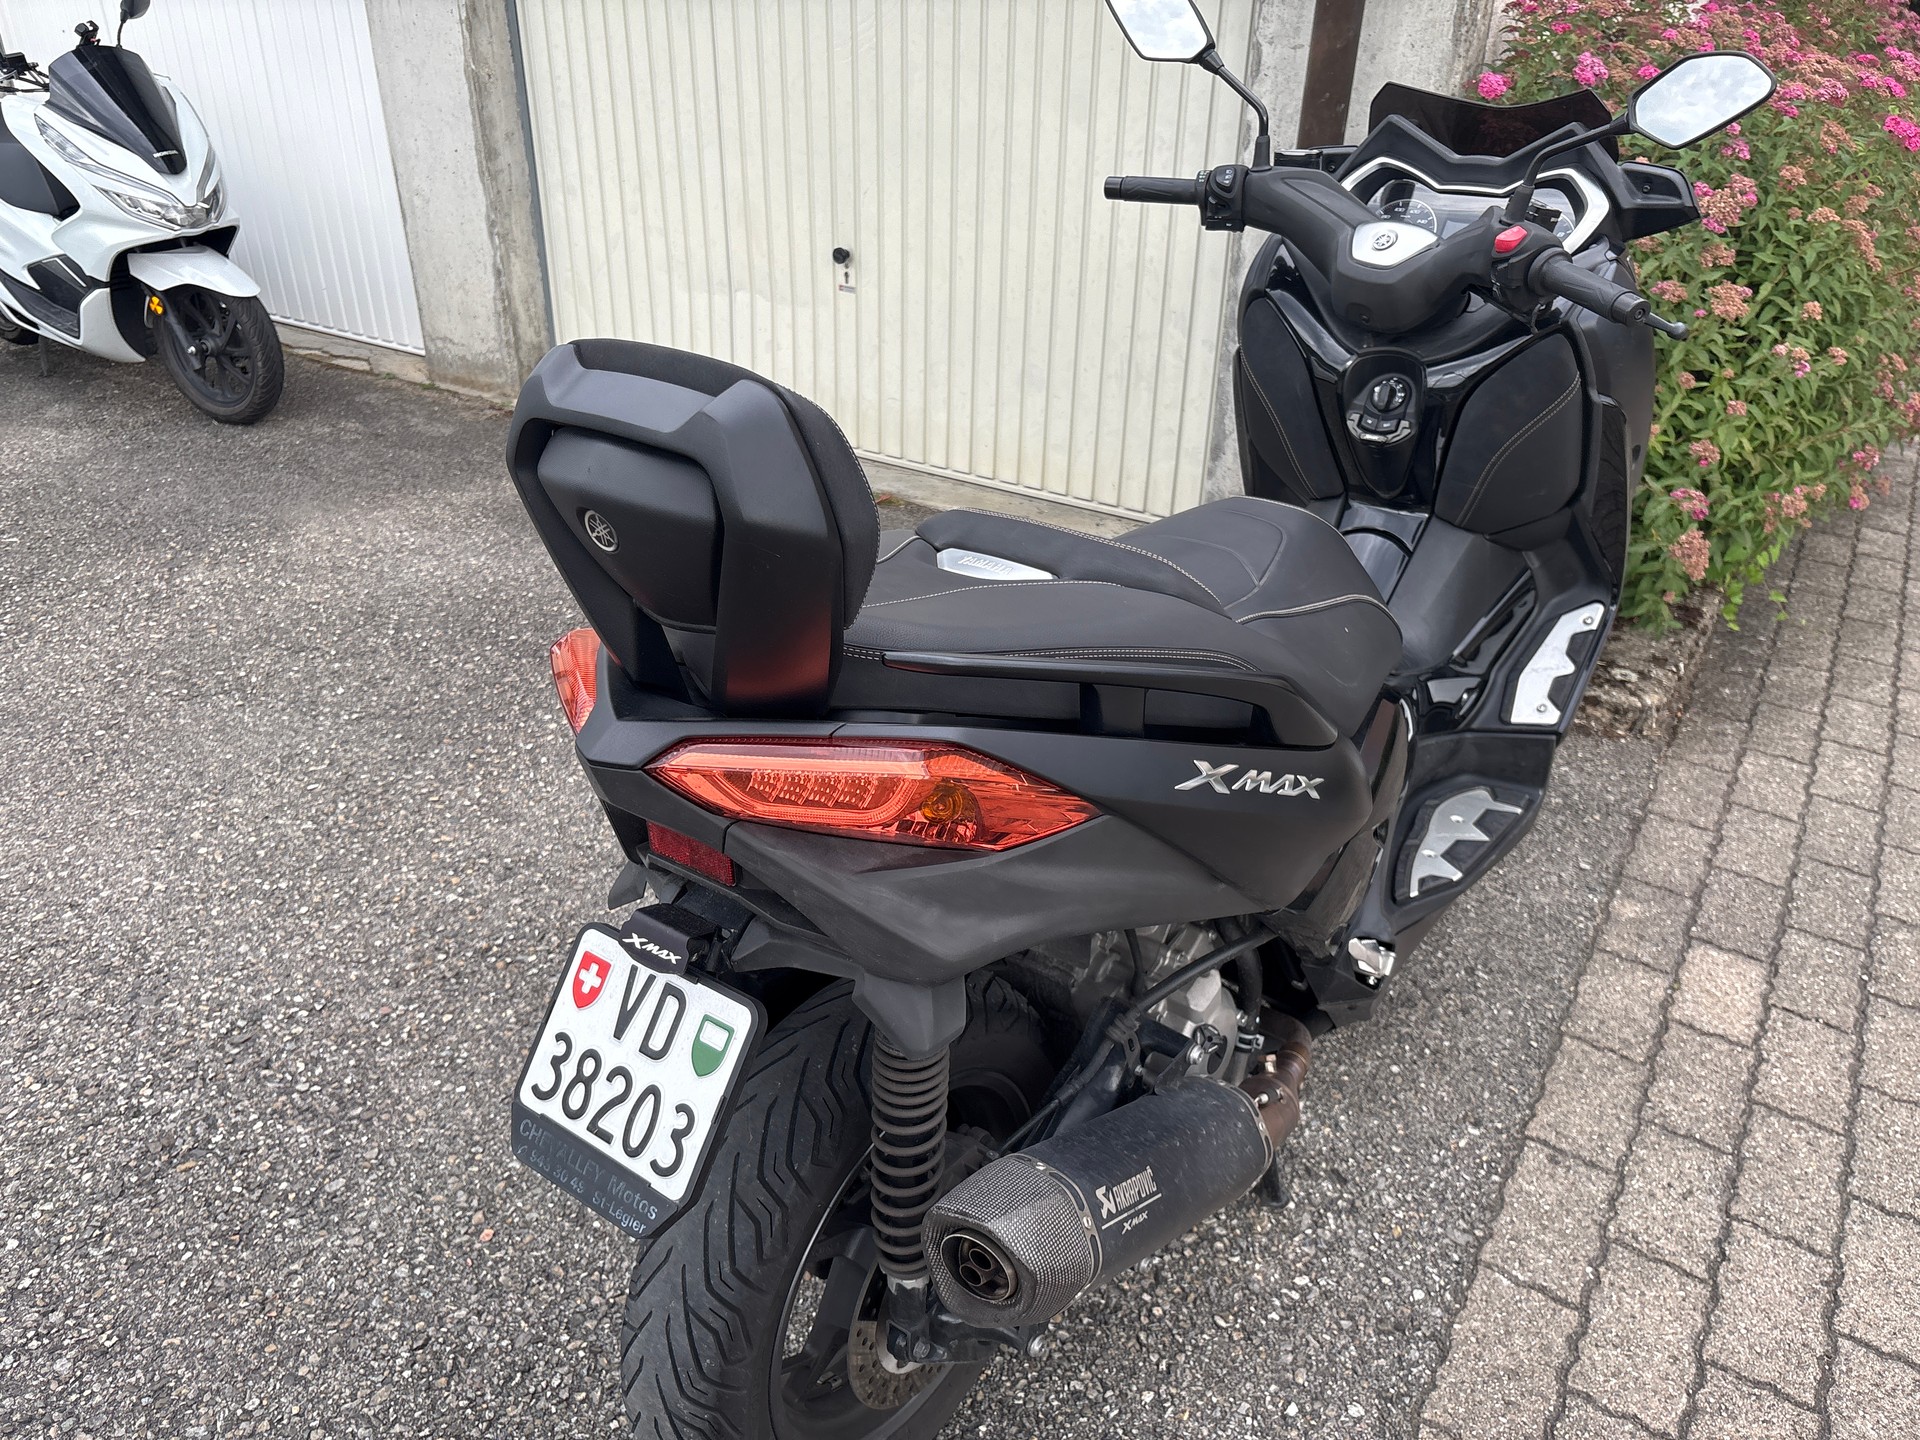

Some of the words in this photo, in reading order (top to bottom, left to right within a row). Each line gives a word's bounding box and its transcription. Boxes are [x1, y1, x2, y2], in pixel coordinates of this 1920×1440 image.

[958, 556, 1014, 575] YAMAHA
[612, 964, 688, 1062] VD
[530, 1031, 696, 1178] 38203
[592, 1190, 647, 1234] St-Légier
[608, 1174, 658, 1220] Motos
